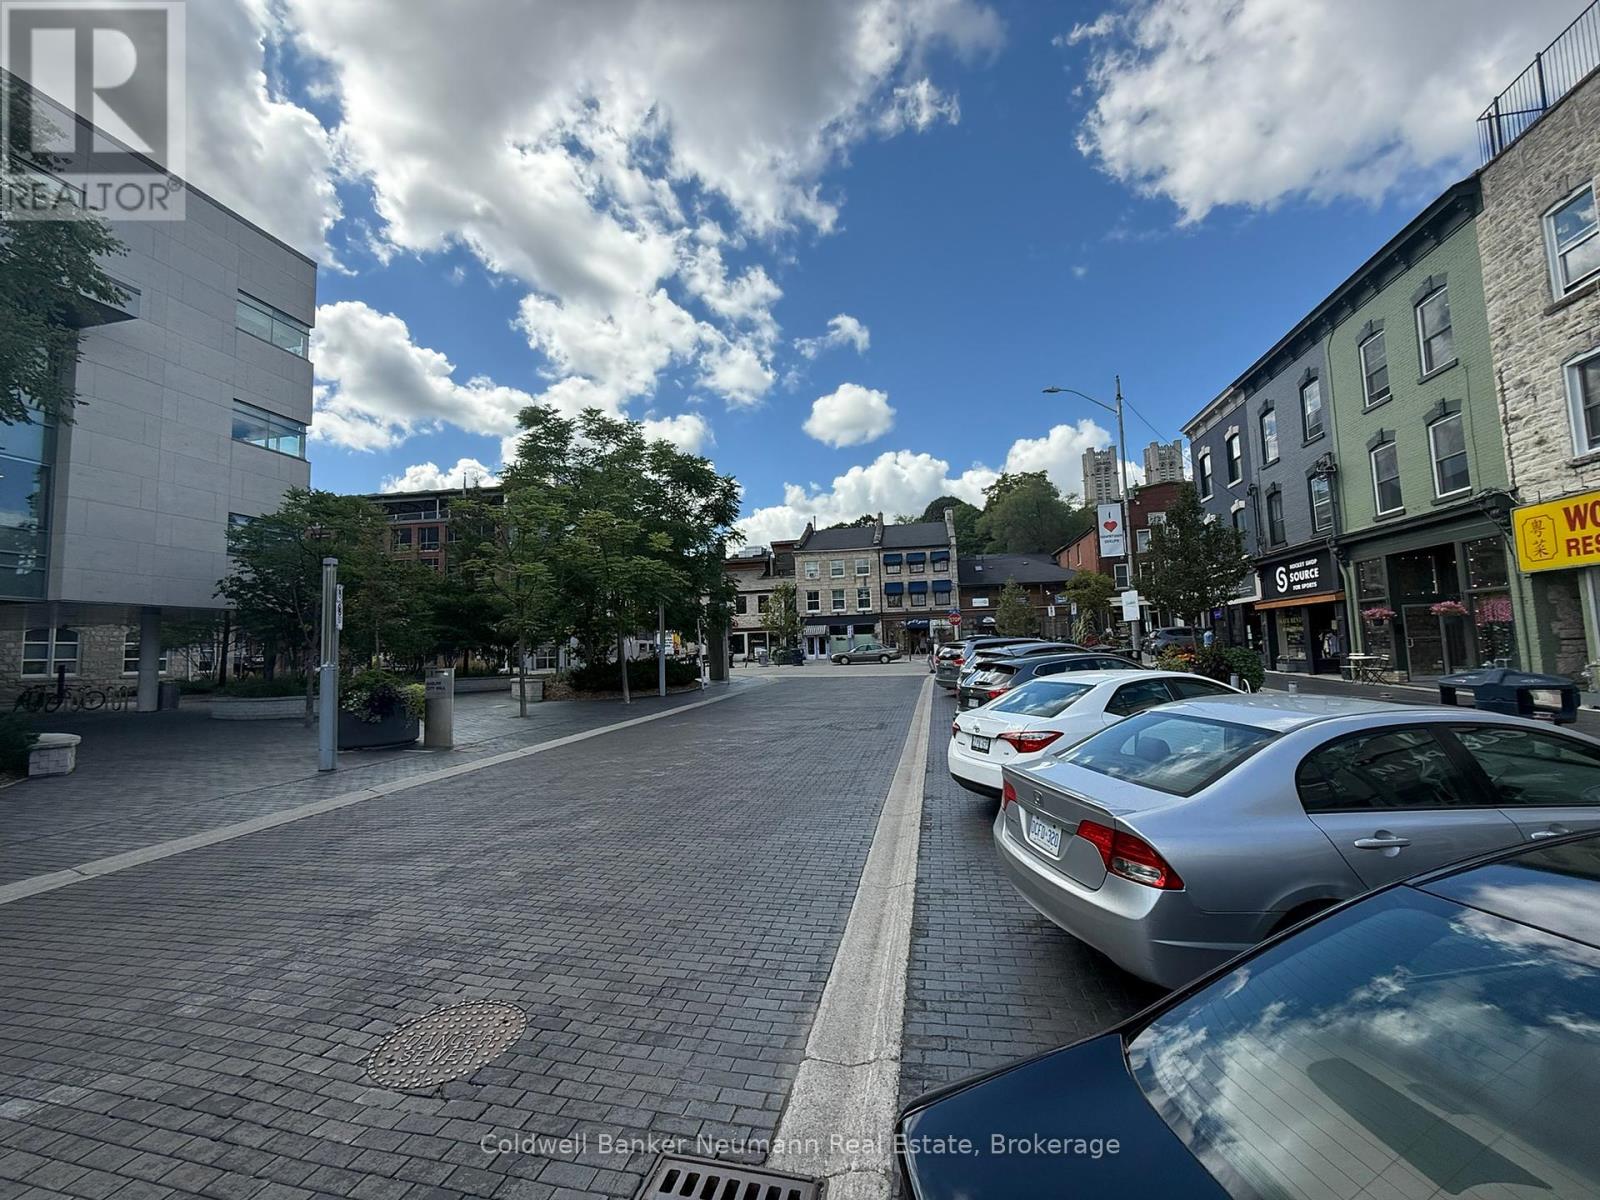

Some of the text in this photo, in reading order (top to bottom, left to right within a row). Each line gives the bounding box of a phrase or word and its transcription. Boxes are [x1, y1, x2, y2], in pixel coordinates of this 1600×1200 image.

[1289, 567, 1319, 582] SOURCE
[404, 1033, 495, 1048] DANGER
[398, 1047, 477, 1063] SEWER
